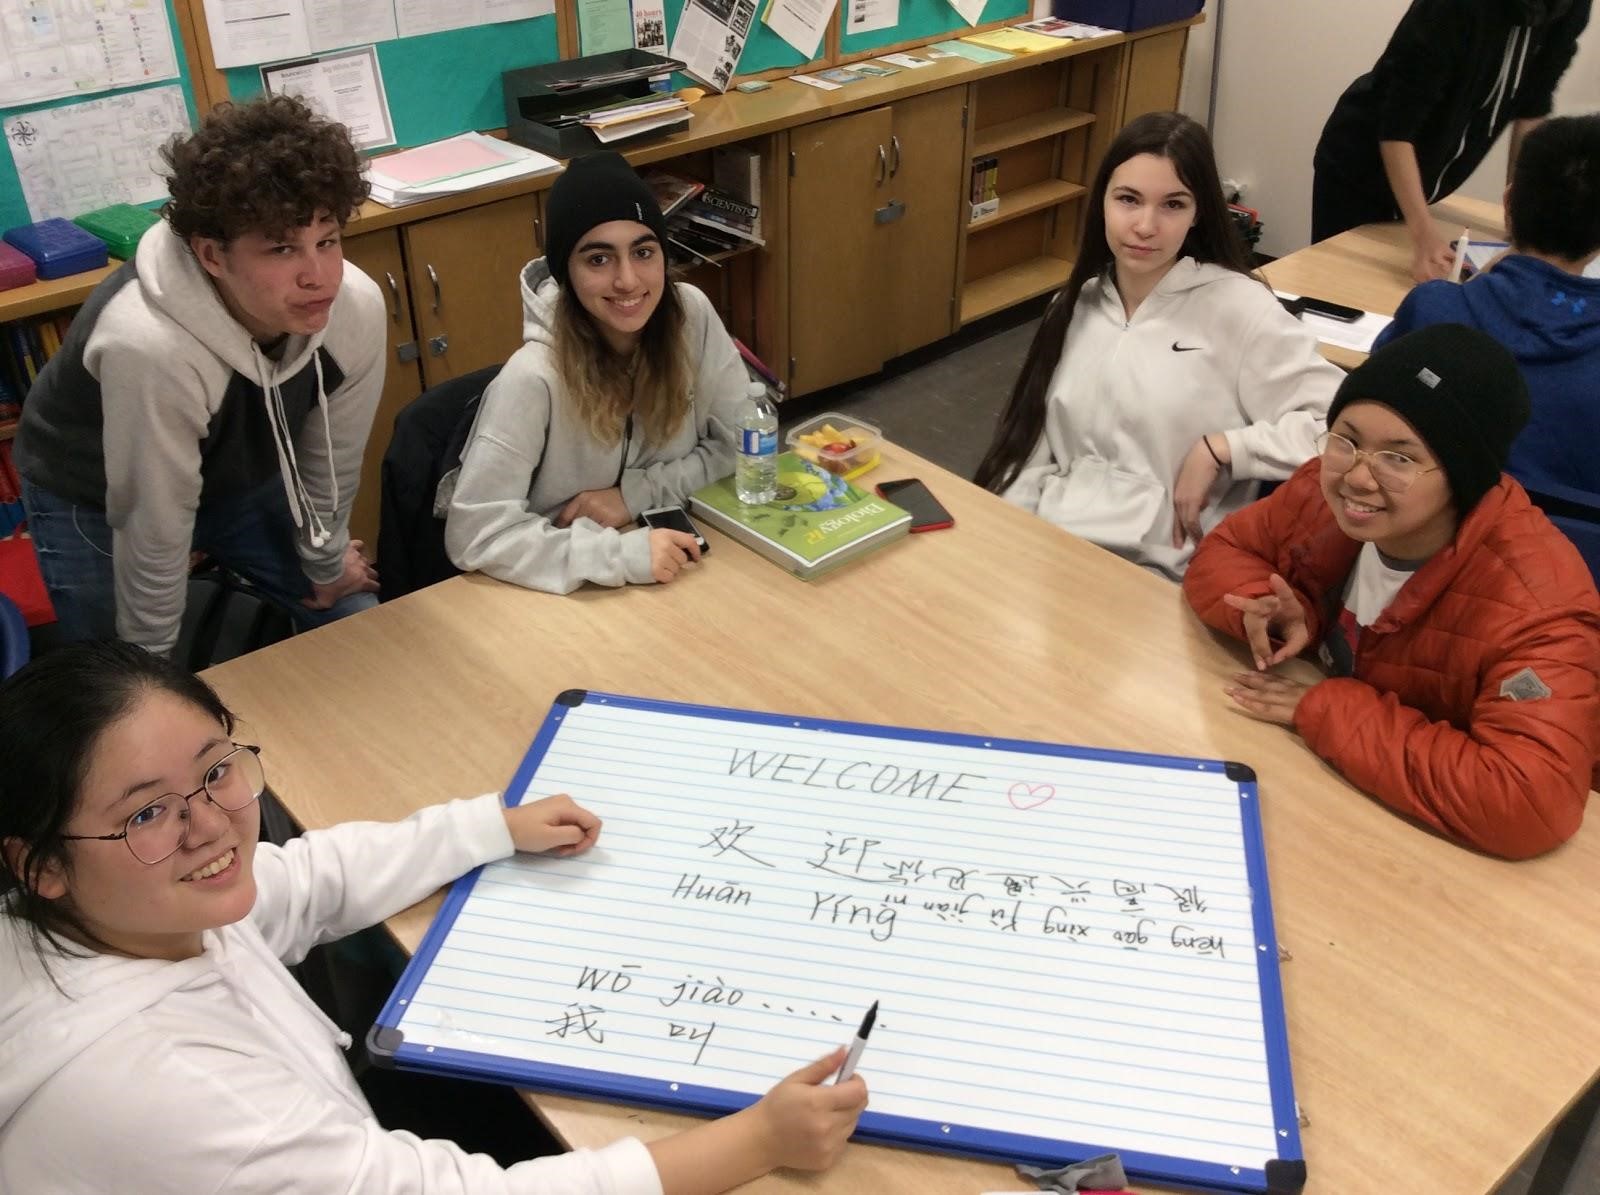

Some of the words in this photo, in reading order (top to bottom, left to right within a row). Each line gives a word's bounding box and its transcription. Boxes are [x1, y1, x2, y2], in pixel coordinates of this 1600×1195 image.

[705, 195, 753, 217] SCIENTISTS
[819, 503, 886, 534] Biology
[729, 748, 988, 803] WELCOME
[699, 819, 776, 868] 欢
[806, 831, 901, 882] 迎
[545, 1003, 606, 1044] 我
[669, 1022, 715, 1066] 叫
